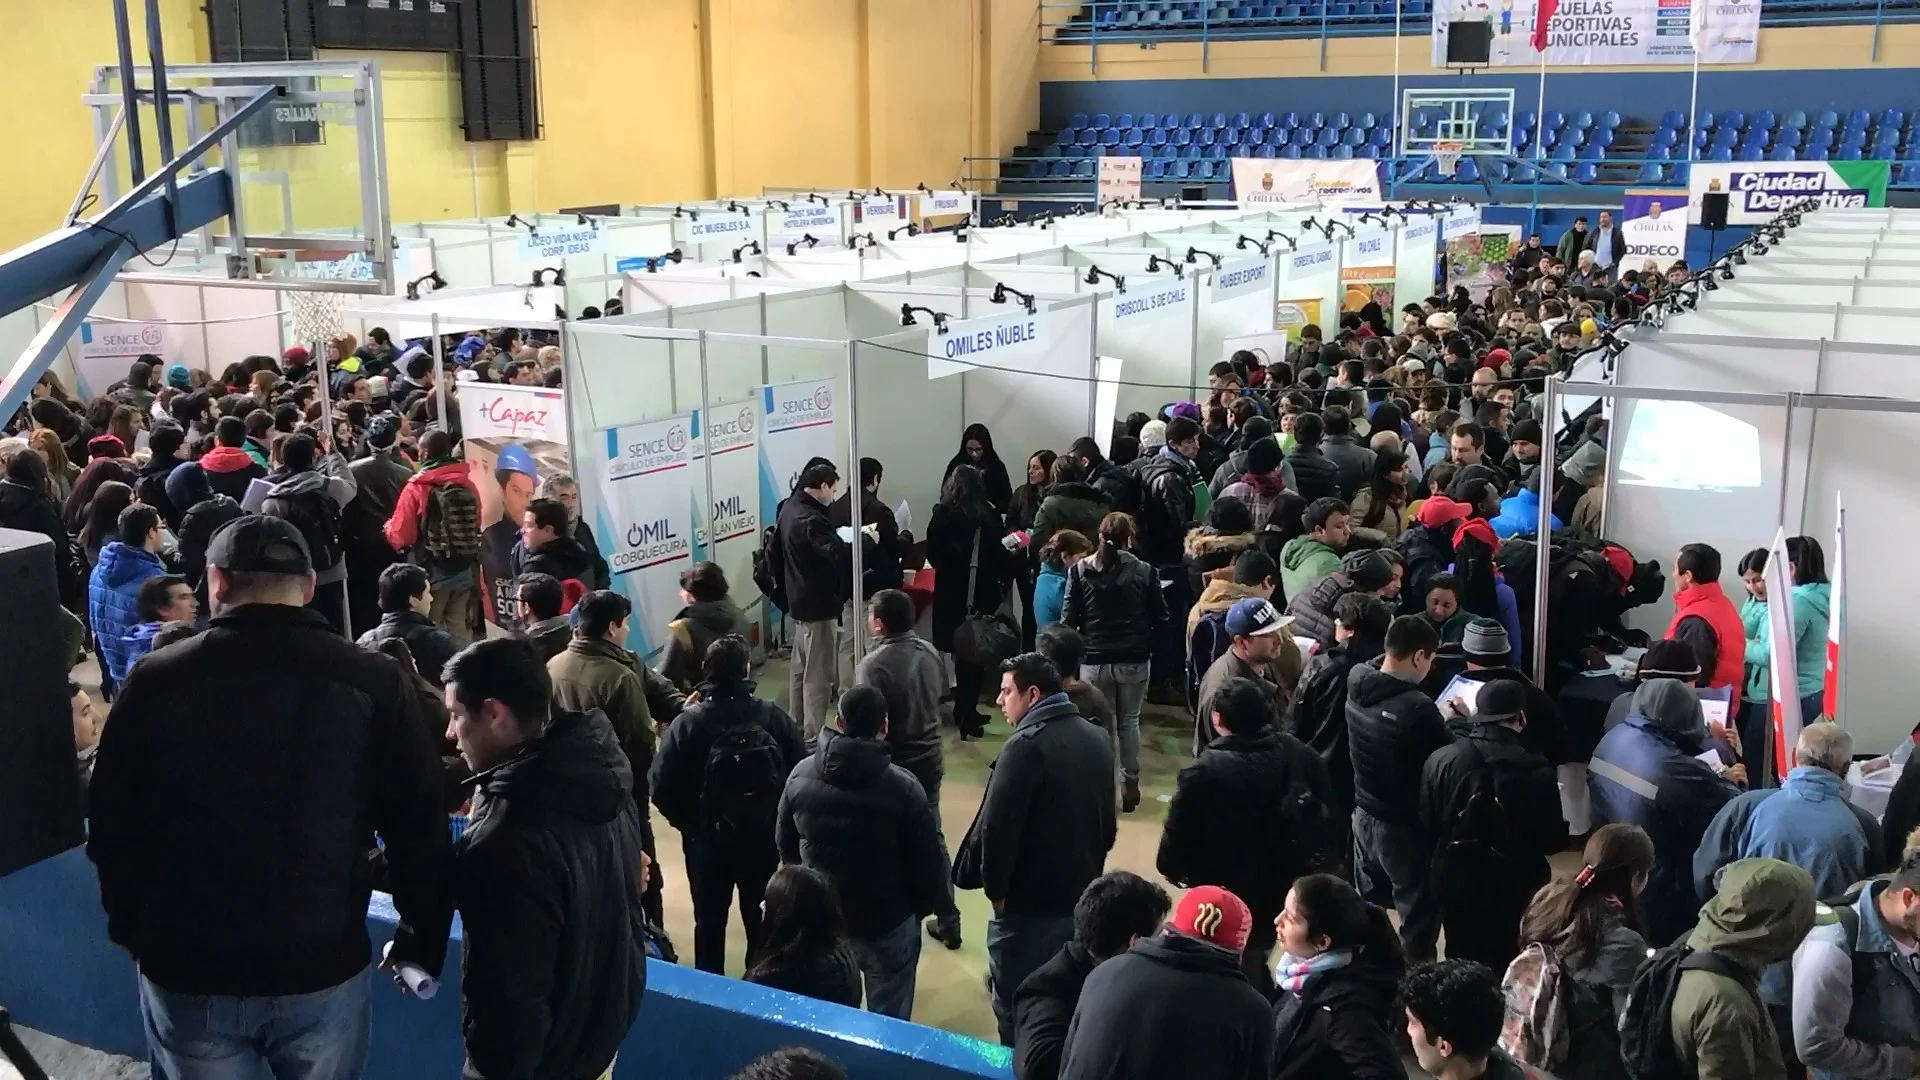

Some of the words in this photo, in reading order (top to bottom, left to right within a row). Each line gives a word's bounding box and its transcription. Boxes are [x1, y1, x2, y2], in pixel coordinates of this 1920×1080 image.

[1739, 172, 1825, 191] Ciudad
[1625, 244, 1679, 256] DIDECO
[1243, 264, 1265, 283] EXPORT
[1167, 288, 1185, 305] CHILE
[103, 335, 139, 346] SENCE
[946, 331, 993, 358] OMILES
[996, 322, 1035, 347] ÑUBLE
[783, 397, 814, 414] SENCE
[629, 439, 666, 458] SENCE
[733, 515, 755, 530] VIEJO
[627, 518, 676, 547] OMIL
[613, 539, 688, 567] COBQUECURA
